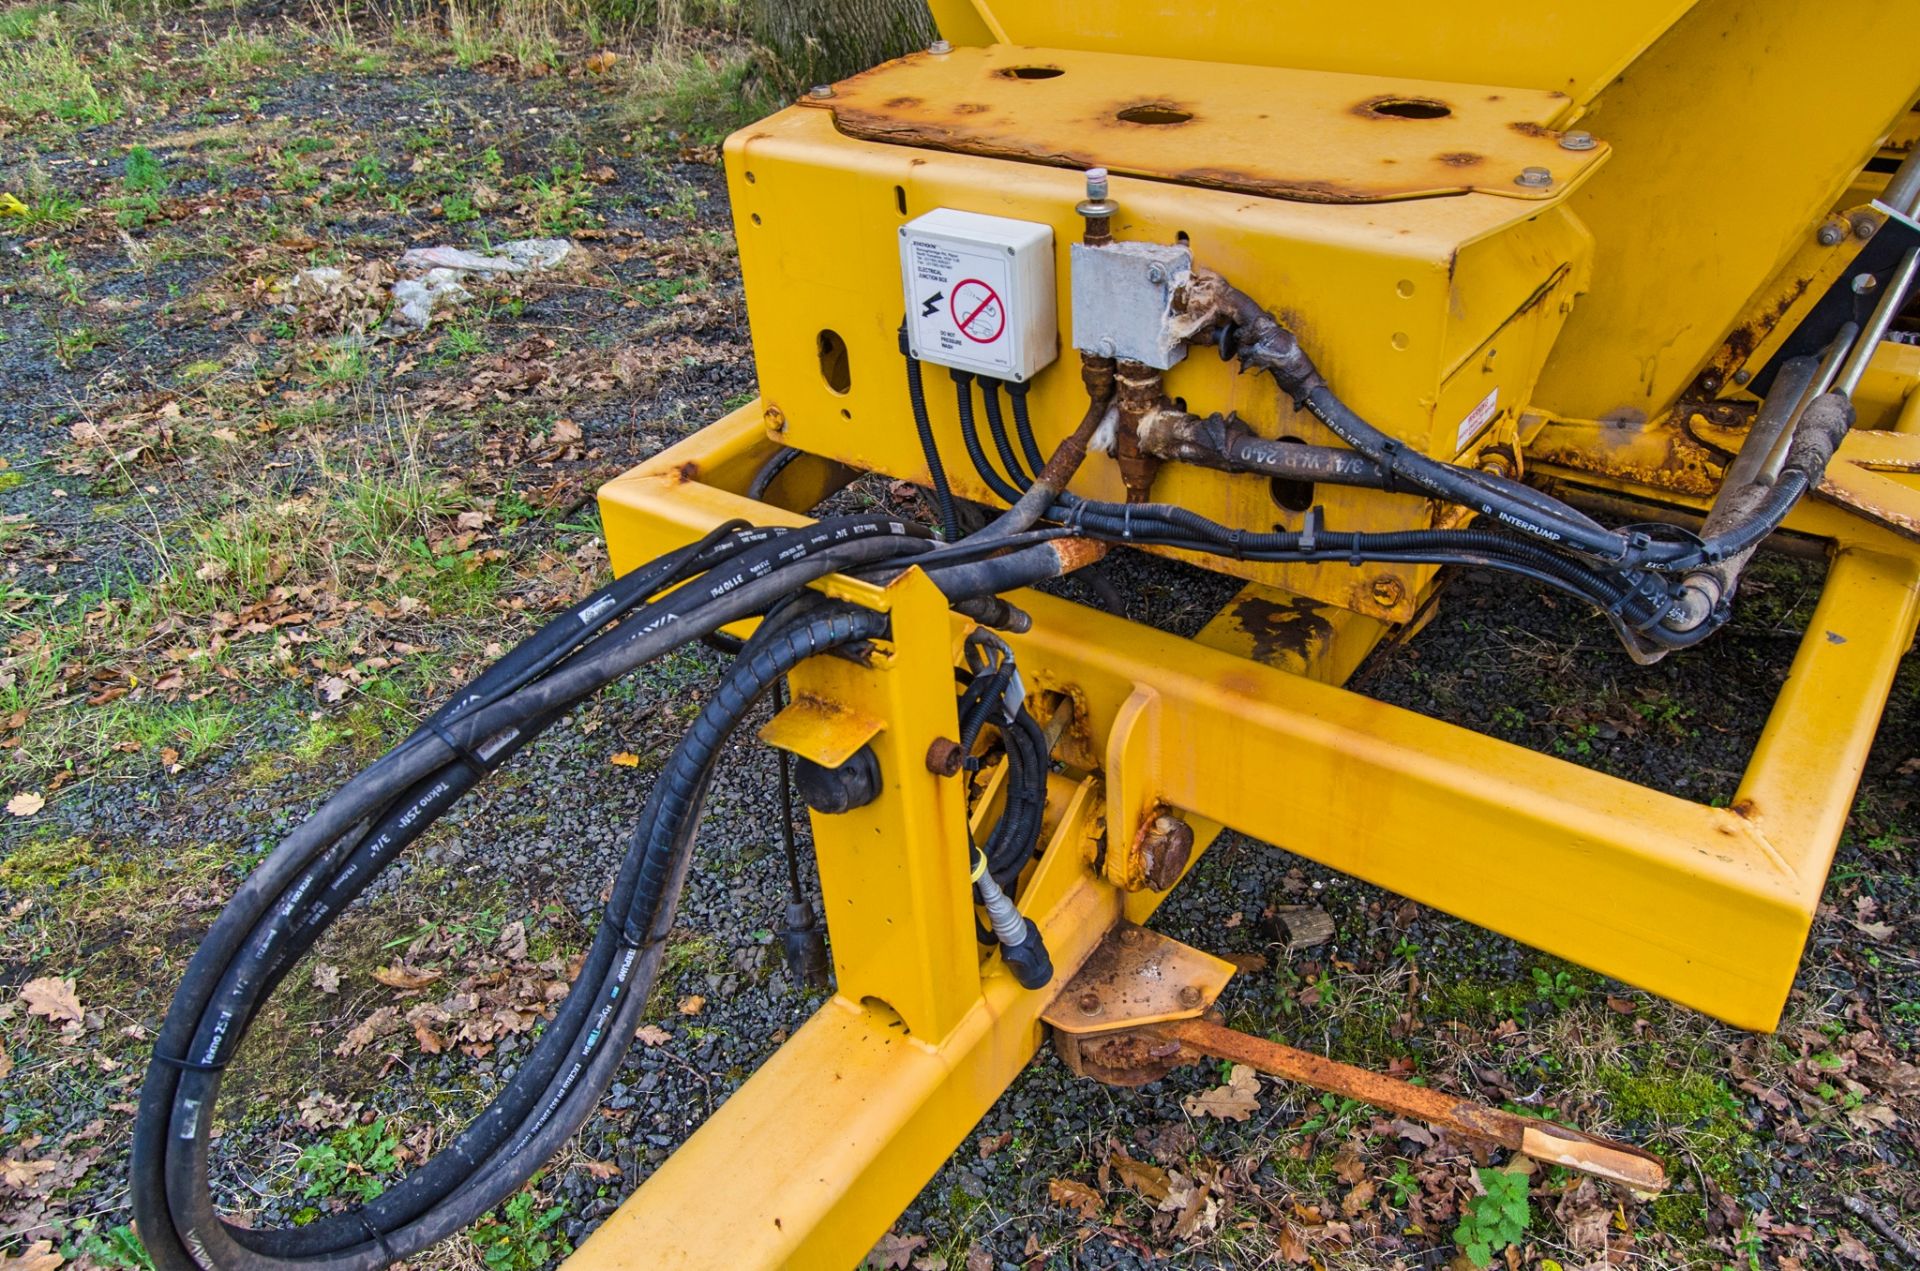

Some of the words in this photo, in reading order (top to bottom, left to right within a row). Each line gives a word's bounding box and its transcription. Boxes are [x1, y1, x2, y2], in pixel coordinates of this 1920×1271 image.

[1498, 511, 1561, 541] INTERPUMP
[723, 574, 745, 590] 3110
[419, 781, 450, 808] Tekno
[370, 833, 391, 858] 3/4"
